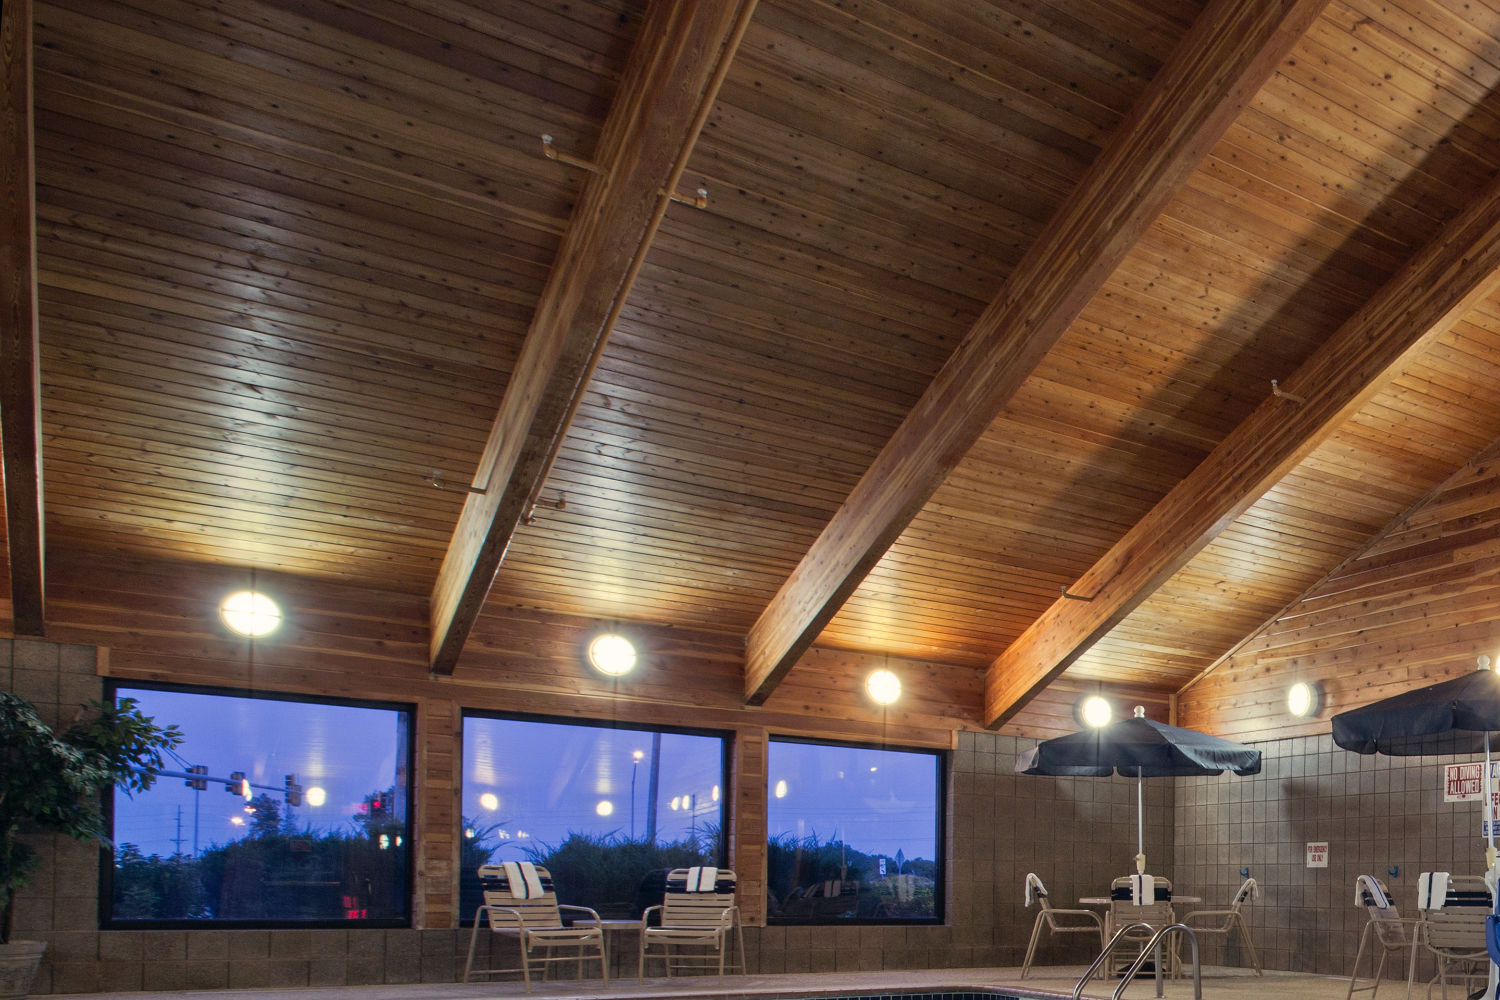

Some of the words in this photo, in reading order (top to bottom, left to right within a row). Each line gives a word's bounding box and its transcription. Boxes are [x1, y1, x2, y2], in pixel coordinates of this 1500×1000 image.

[1449, 767, 1458, 780] NO
[1460, 765, 1480, 779] DIVING
[1449, 779, 1480, 795] ALLOWED
